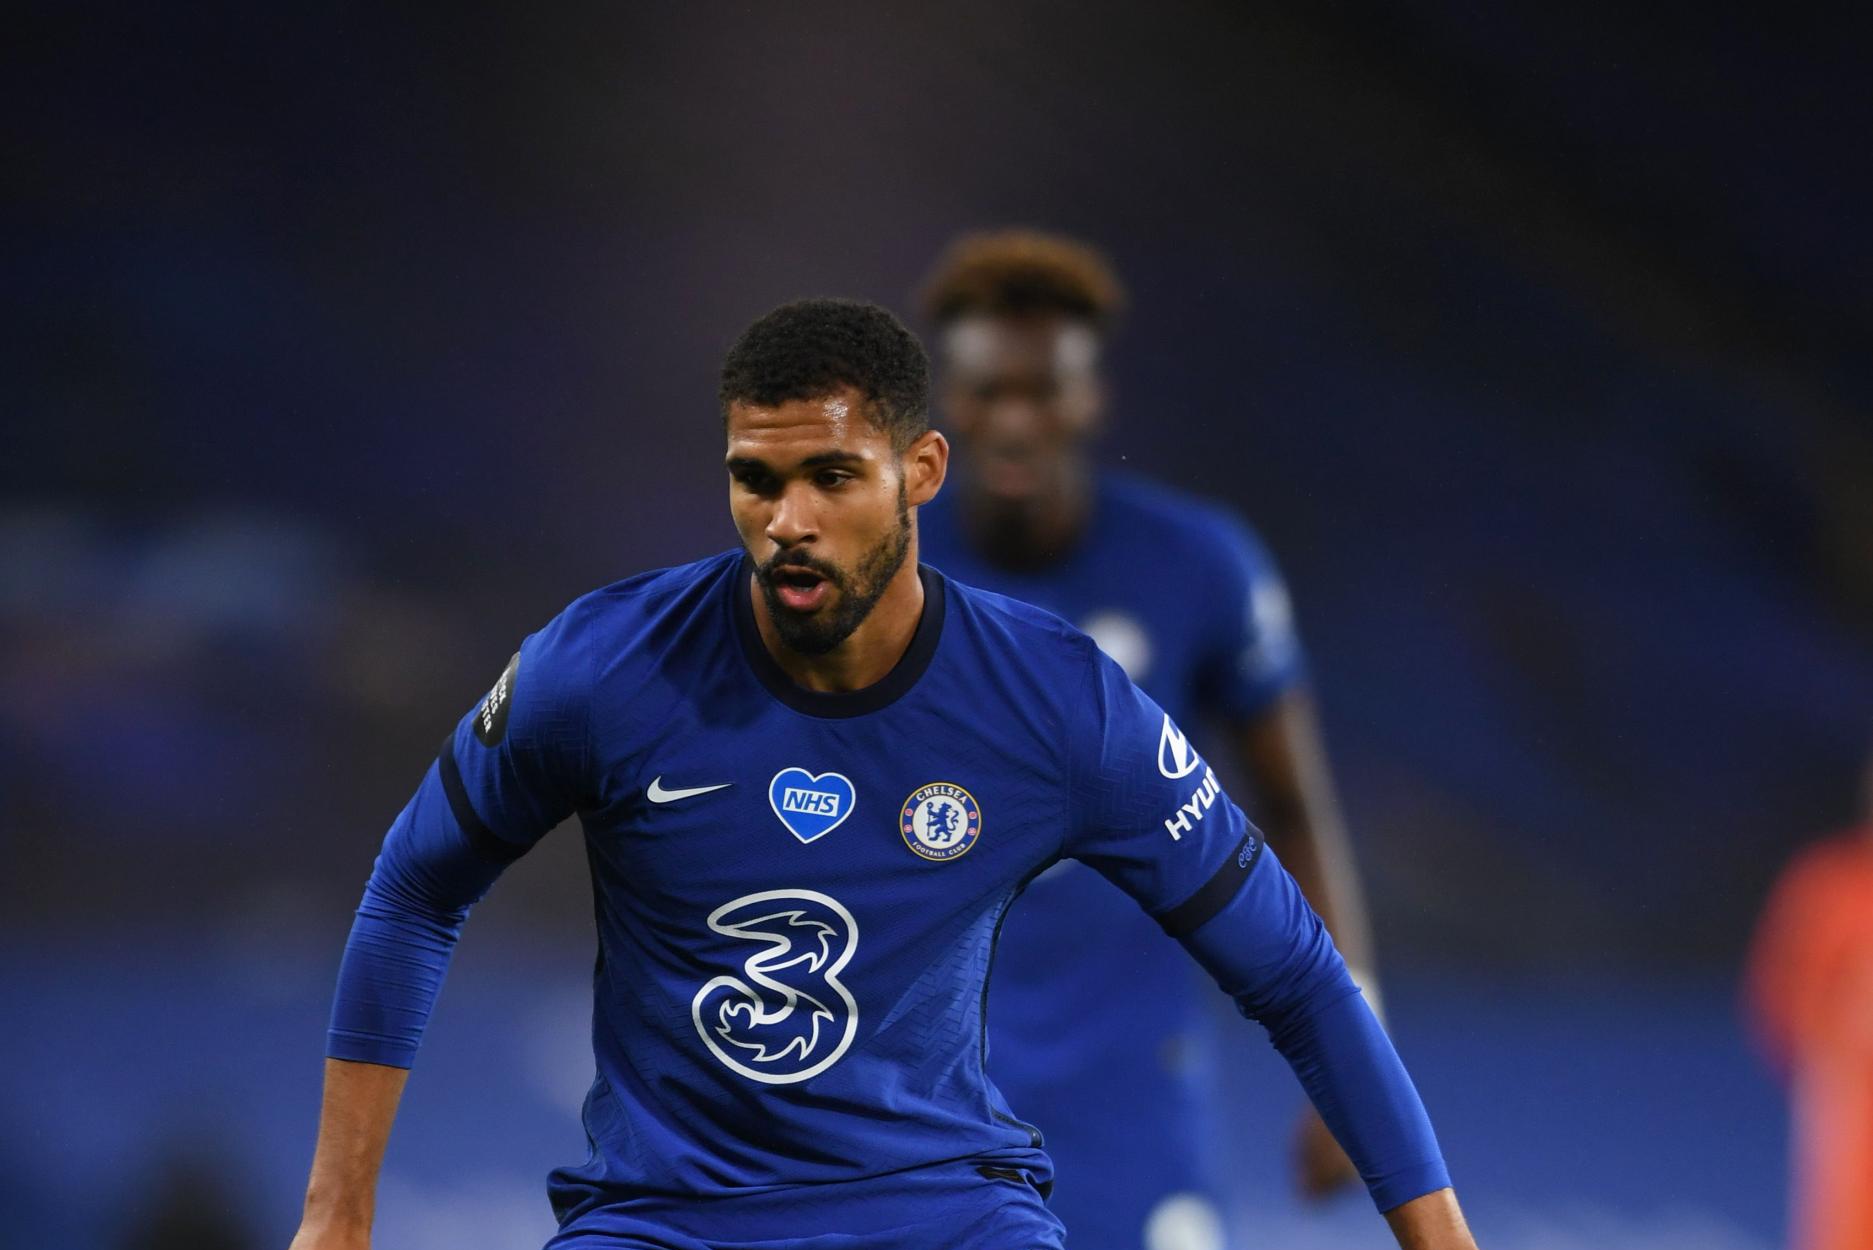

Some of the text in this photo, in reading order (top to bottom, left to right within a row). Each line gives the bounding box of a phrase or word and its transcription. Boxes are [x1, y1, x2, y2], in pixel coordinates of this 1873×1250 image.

[786, 790, 837, 814] NHS
[916, 786, 968, 804] CHELSEA
[912, 841, 946, 857] FOOTBALL
[692, 888, 859, 1085] 3
